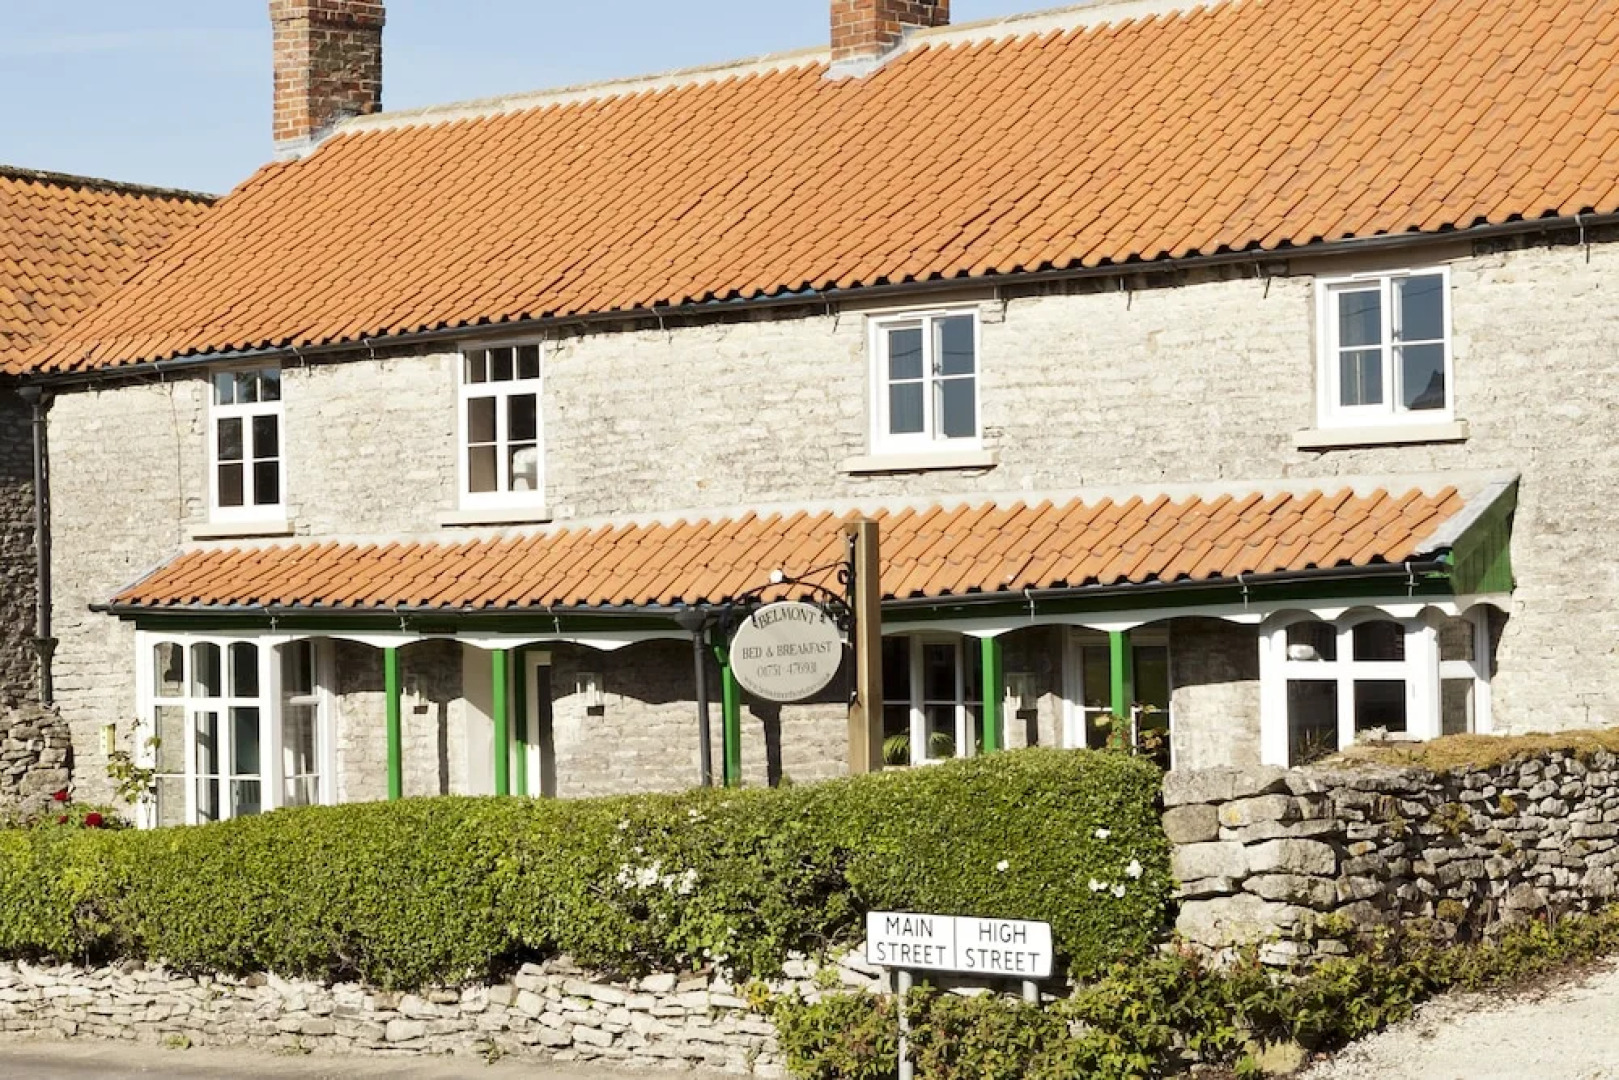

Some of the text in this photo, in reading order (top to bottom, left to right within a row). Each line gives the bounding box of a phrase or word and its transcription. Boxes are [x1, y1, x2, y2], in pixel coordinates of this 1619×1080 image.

[758, 607, 816, 629] BELMONT
[742, 641, 832, 659] BED & BREAKFAST
[885, 916, 933, 938] MAIN
[978, 921, 1027, 945] HIGH
[876, 941, 946, 965] STREET
[965, 948, 1041, 972] STREET
